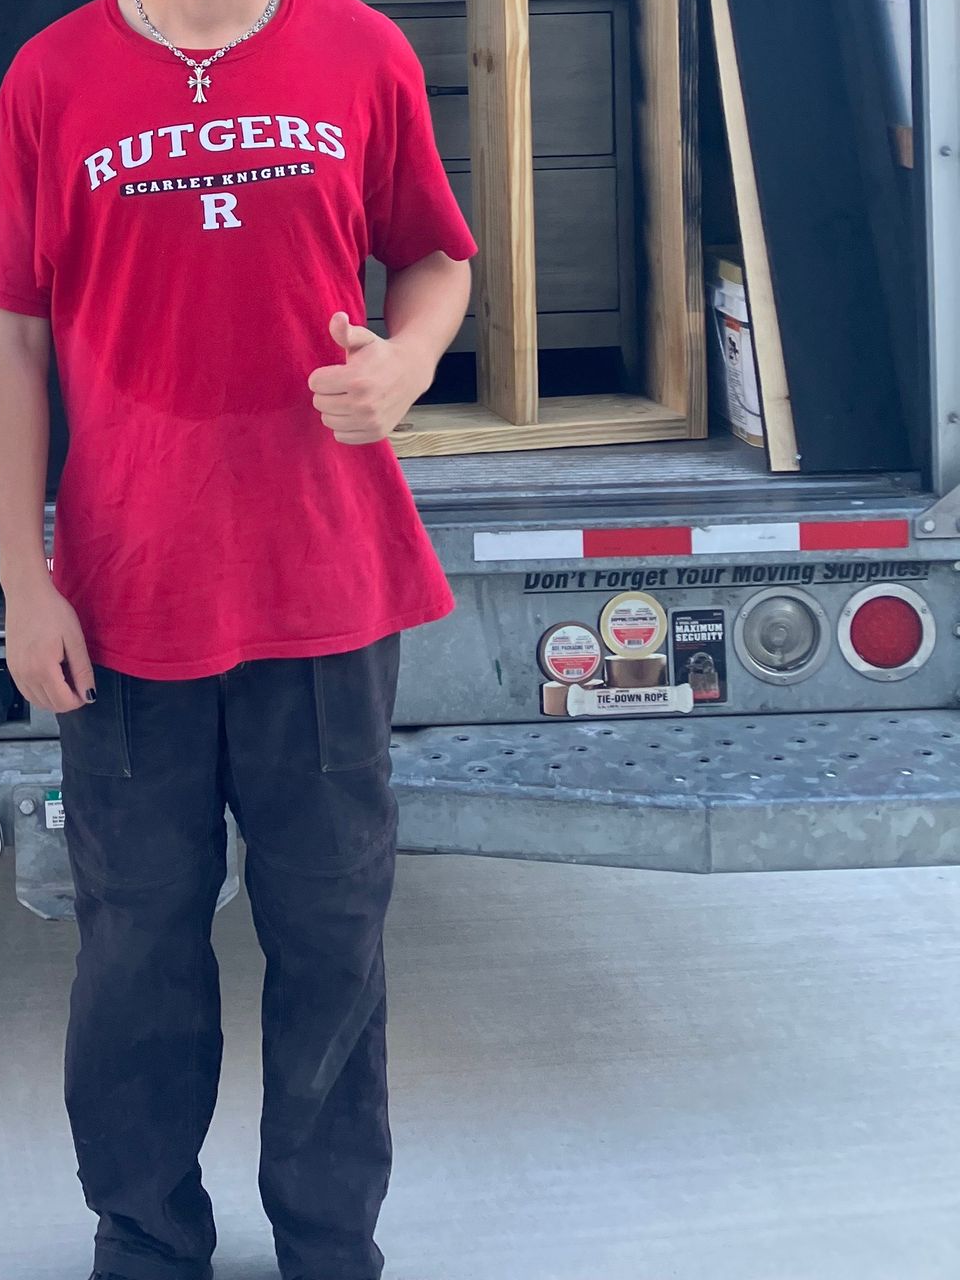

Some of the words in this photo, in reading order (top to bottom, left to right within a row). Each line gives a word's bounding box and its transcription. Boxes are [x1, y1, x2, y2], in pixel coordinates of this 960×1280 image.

[84, 115, 346, 191] RUTGERS
[125, 176, 214, 195] SCARLET
[200, 192, 242, 230] R
[524, 571, 586, 589] Don't
[593, 569, 667, 591] Forget
[676, 568, 727, 585] Your
[731, 565, 815, 585] Moving
[675, 623, 723, 633] MAXIMUM
[675, 632, 723, 642] SECURITY
[597, 694, 641, 703] TIE-DOWN
[644, 693, 669, 702] ROPE
